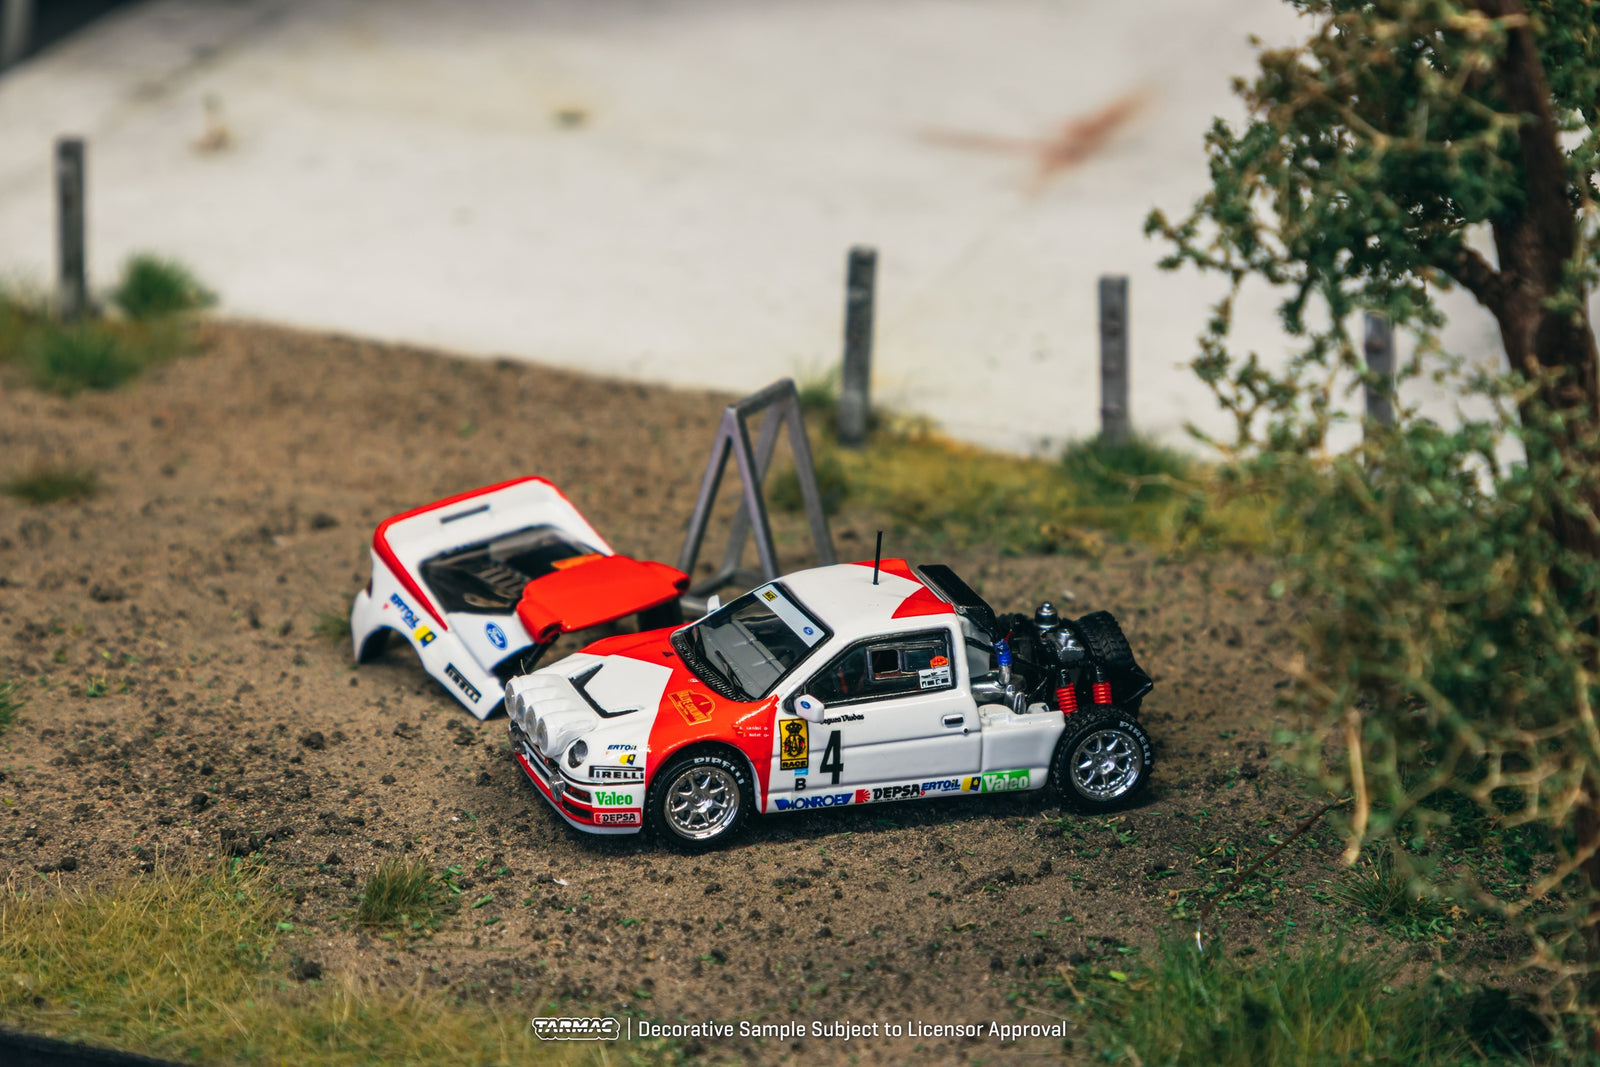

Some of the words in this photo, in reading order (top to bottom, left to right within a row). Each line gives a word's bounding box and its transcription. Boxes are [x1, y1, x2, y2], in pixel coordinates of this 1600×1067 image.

[1120, 721, 1151, 765] PIRELLI
[781, 760, 807, 768] RACE
[820, 730, 844, 785] 4
[795, 778, 807, 791] B
[872, 783, 920, 800] DEPSA
[984, 774, 1029, 792] Valeo
[595, 791, 633, 806] Valeo
[776, 793, 852, 811] MONROE
[602, 812, 636, 822] DEPSA
